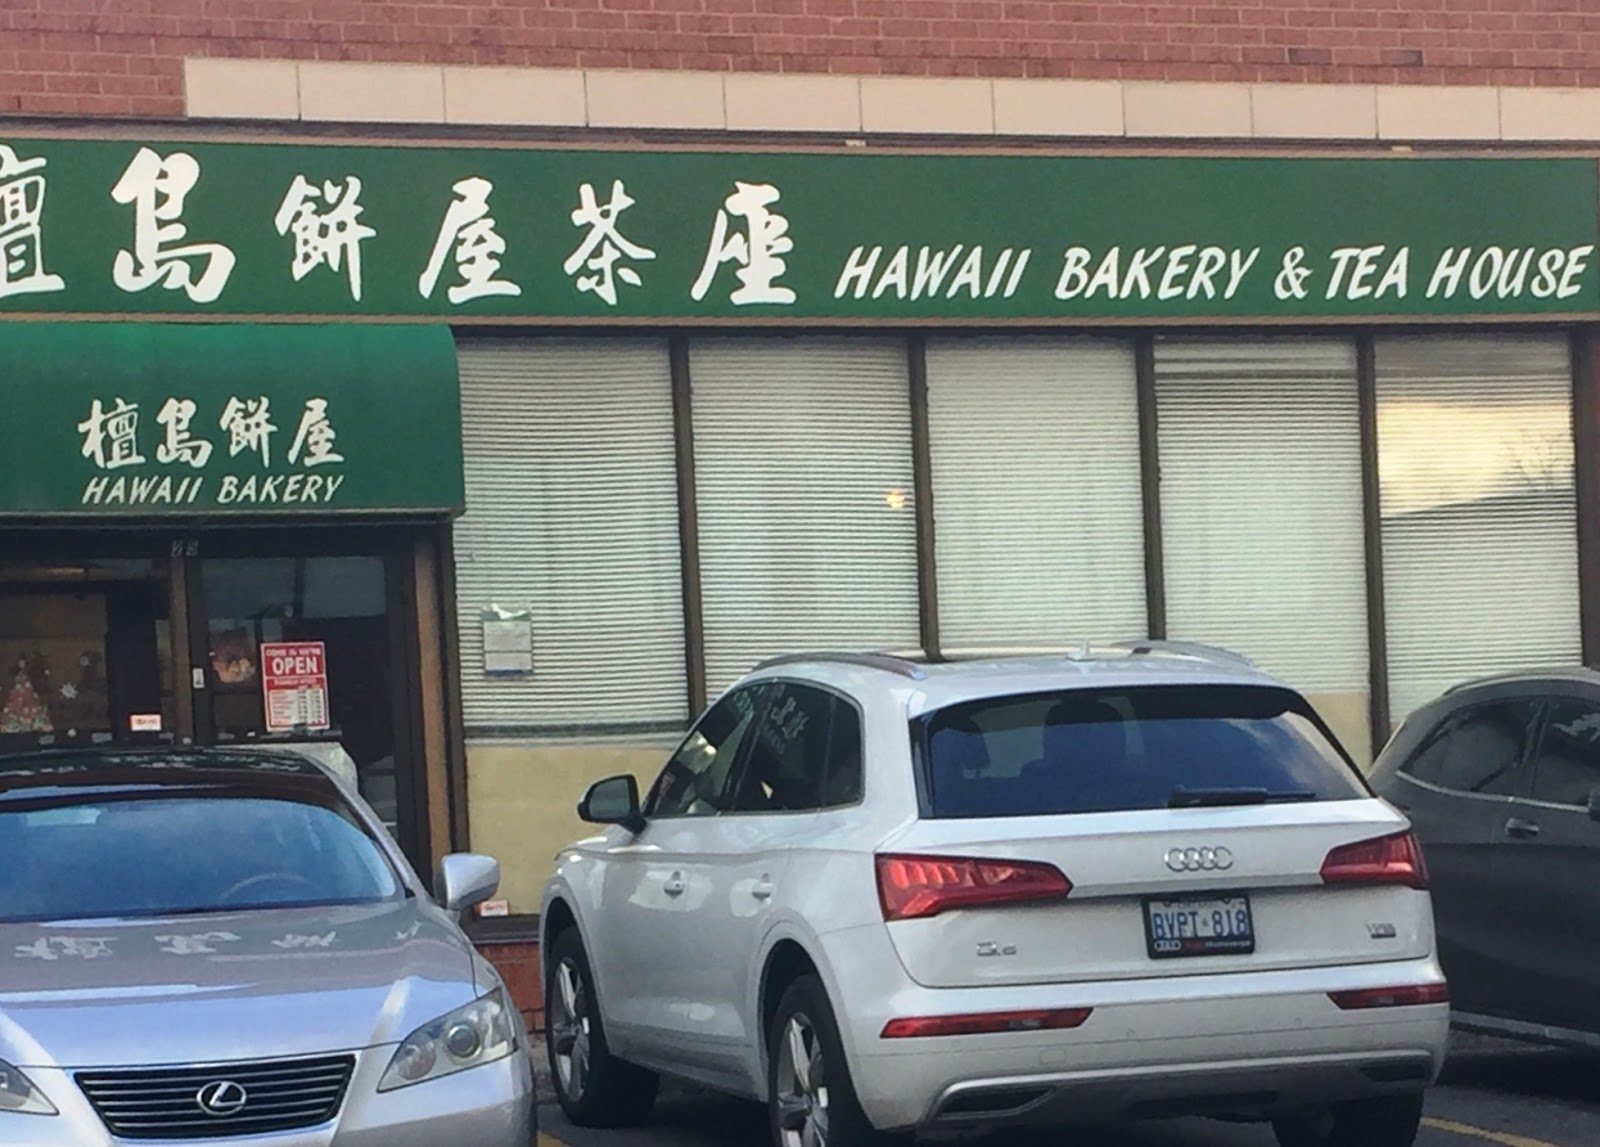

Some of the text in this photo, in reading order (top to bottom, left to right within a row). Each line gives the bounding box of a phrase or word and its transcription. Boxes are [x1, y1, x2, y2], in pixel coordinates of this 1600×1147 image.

[835, 245, 1594, 300] HAWAII BAKERY & TEA HOUSE
[77, 396, 345, 469] 檀島餅屋
[82, 475, 344, 504] HAWAII BAKERY
[272, 656, 318, 675] OPEN
[1212, 910, 1249, 937] 818
